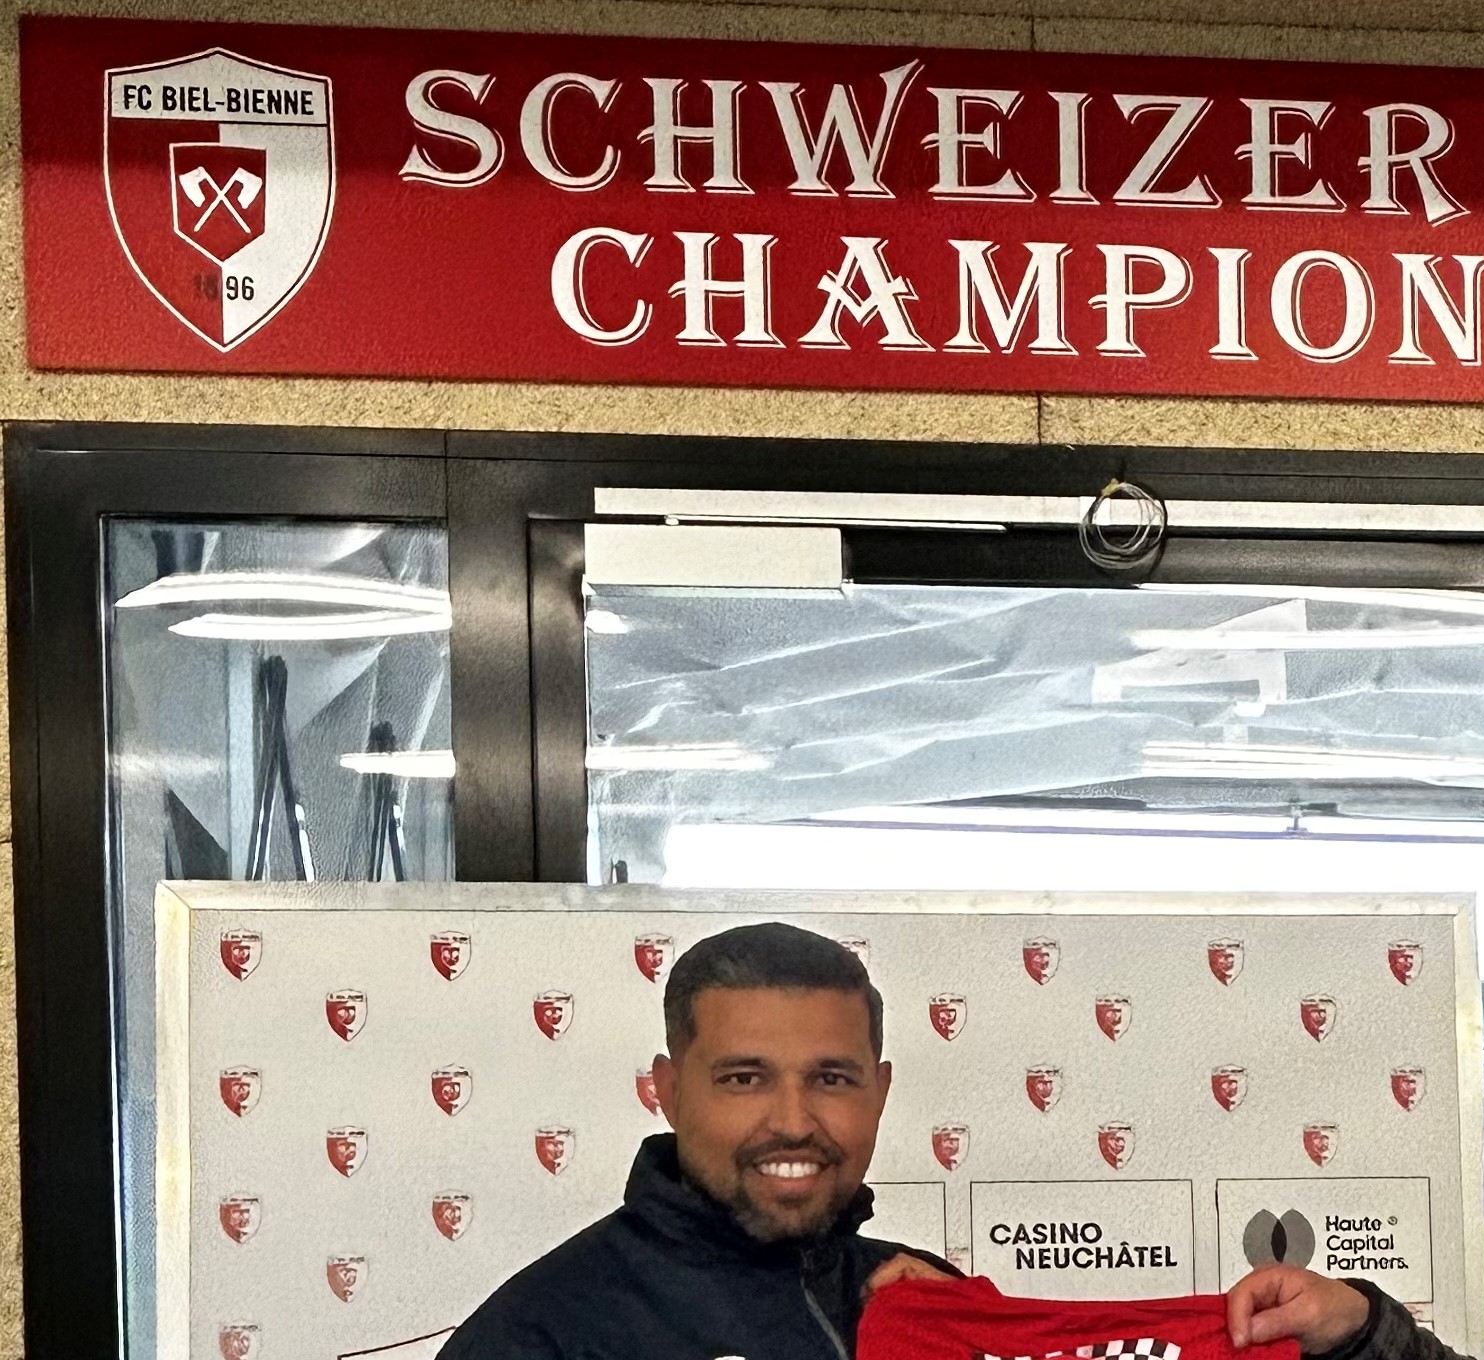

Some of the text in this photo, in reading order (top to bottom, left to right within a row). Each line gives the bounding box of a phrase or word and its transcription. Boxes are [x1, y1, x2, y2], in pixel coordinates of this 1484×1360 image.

[123, 85, 314, 115] FC BIEL-BIENNE
[400, 59, 1471, 228] SCHWEIZER
[989, 1222, 1102, 1246] CASINO
[1325, 1215, 1381, 1232] Haute
[1016, 1241, 1178, 1270] NEUCHÂTEL
[1326, 1235, 1394, 1254] Capital
